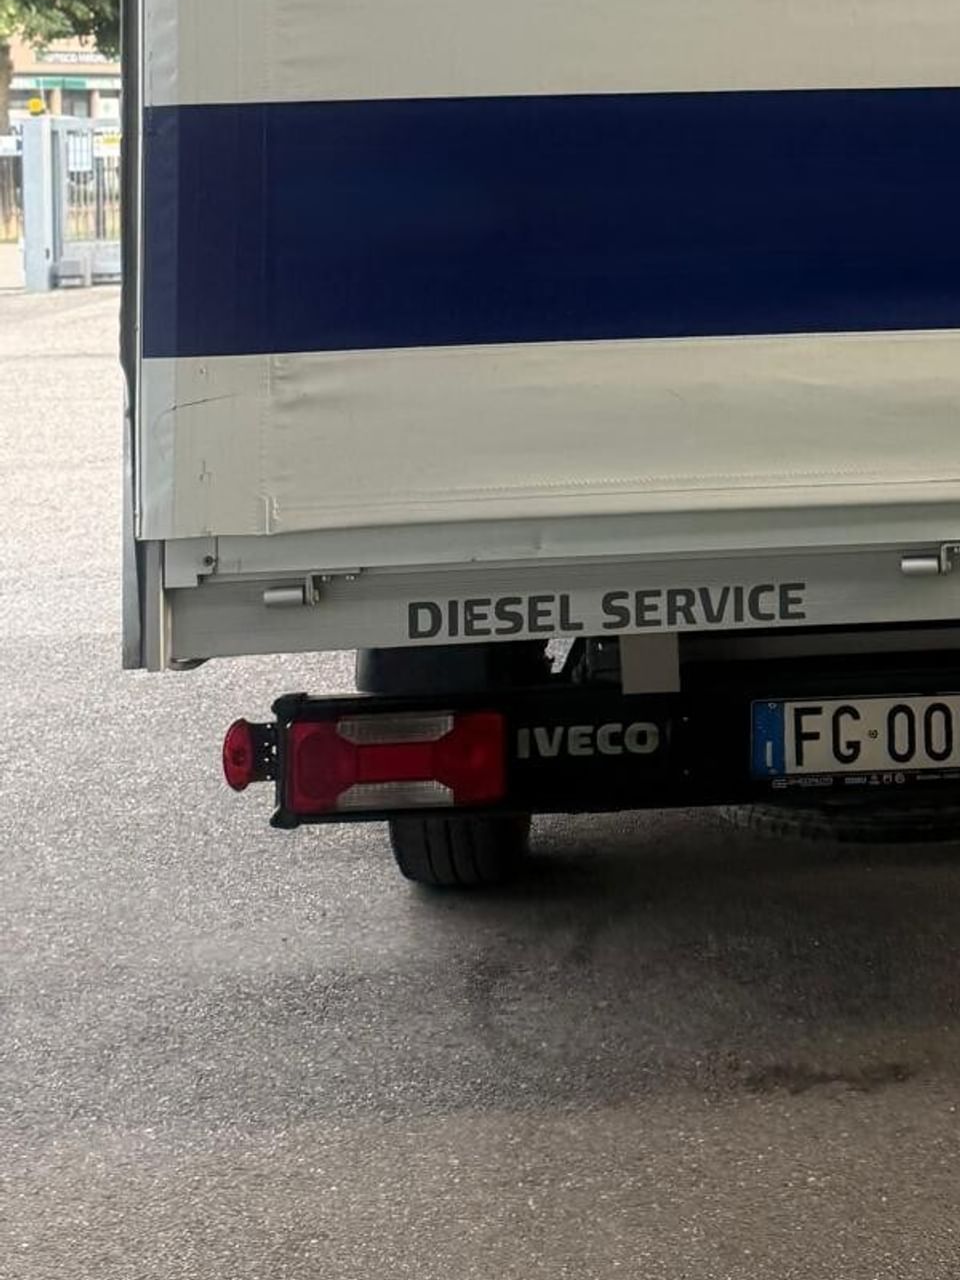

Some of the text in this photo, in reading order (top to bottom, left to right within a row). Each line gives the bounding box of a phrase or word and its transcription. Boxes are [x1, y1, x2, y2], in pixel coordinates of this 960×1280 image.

[407, 583, 806, 639] DIESEL SERVICE
[516, 722, 661, 759] IVECO
